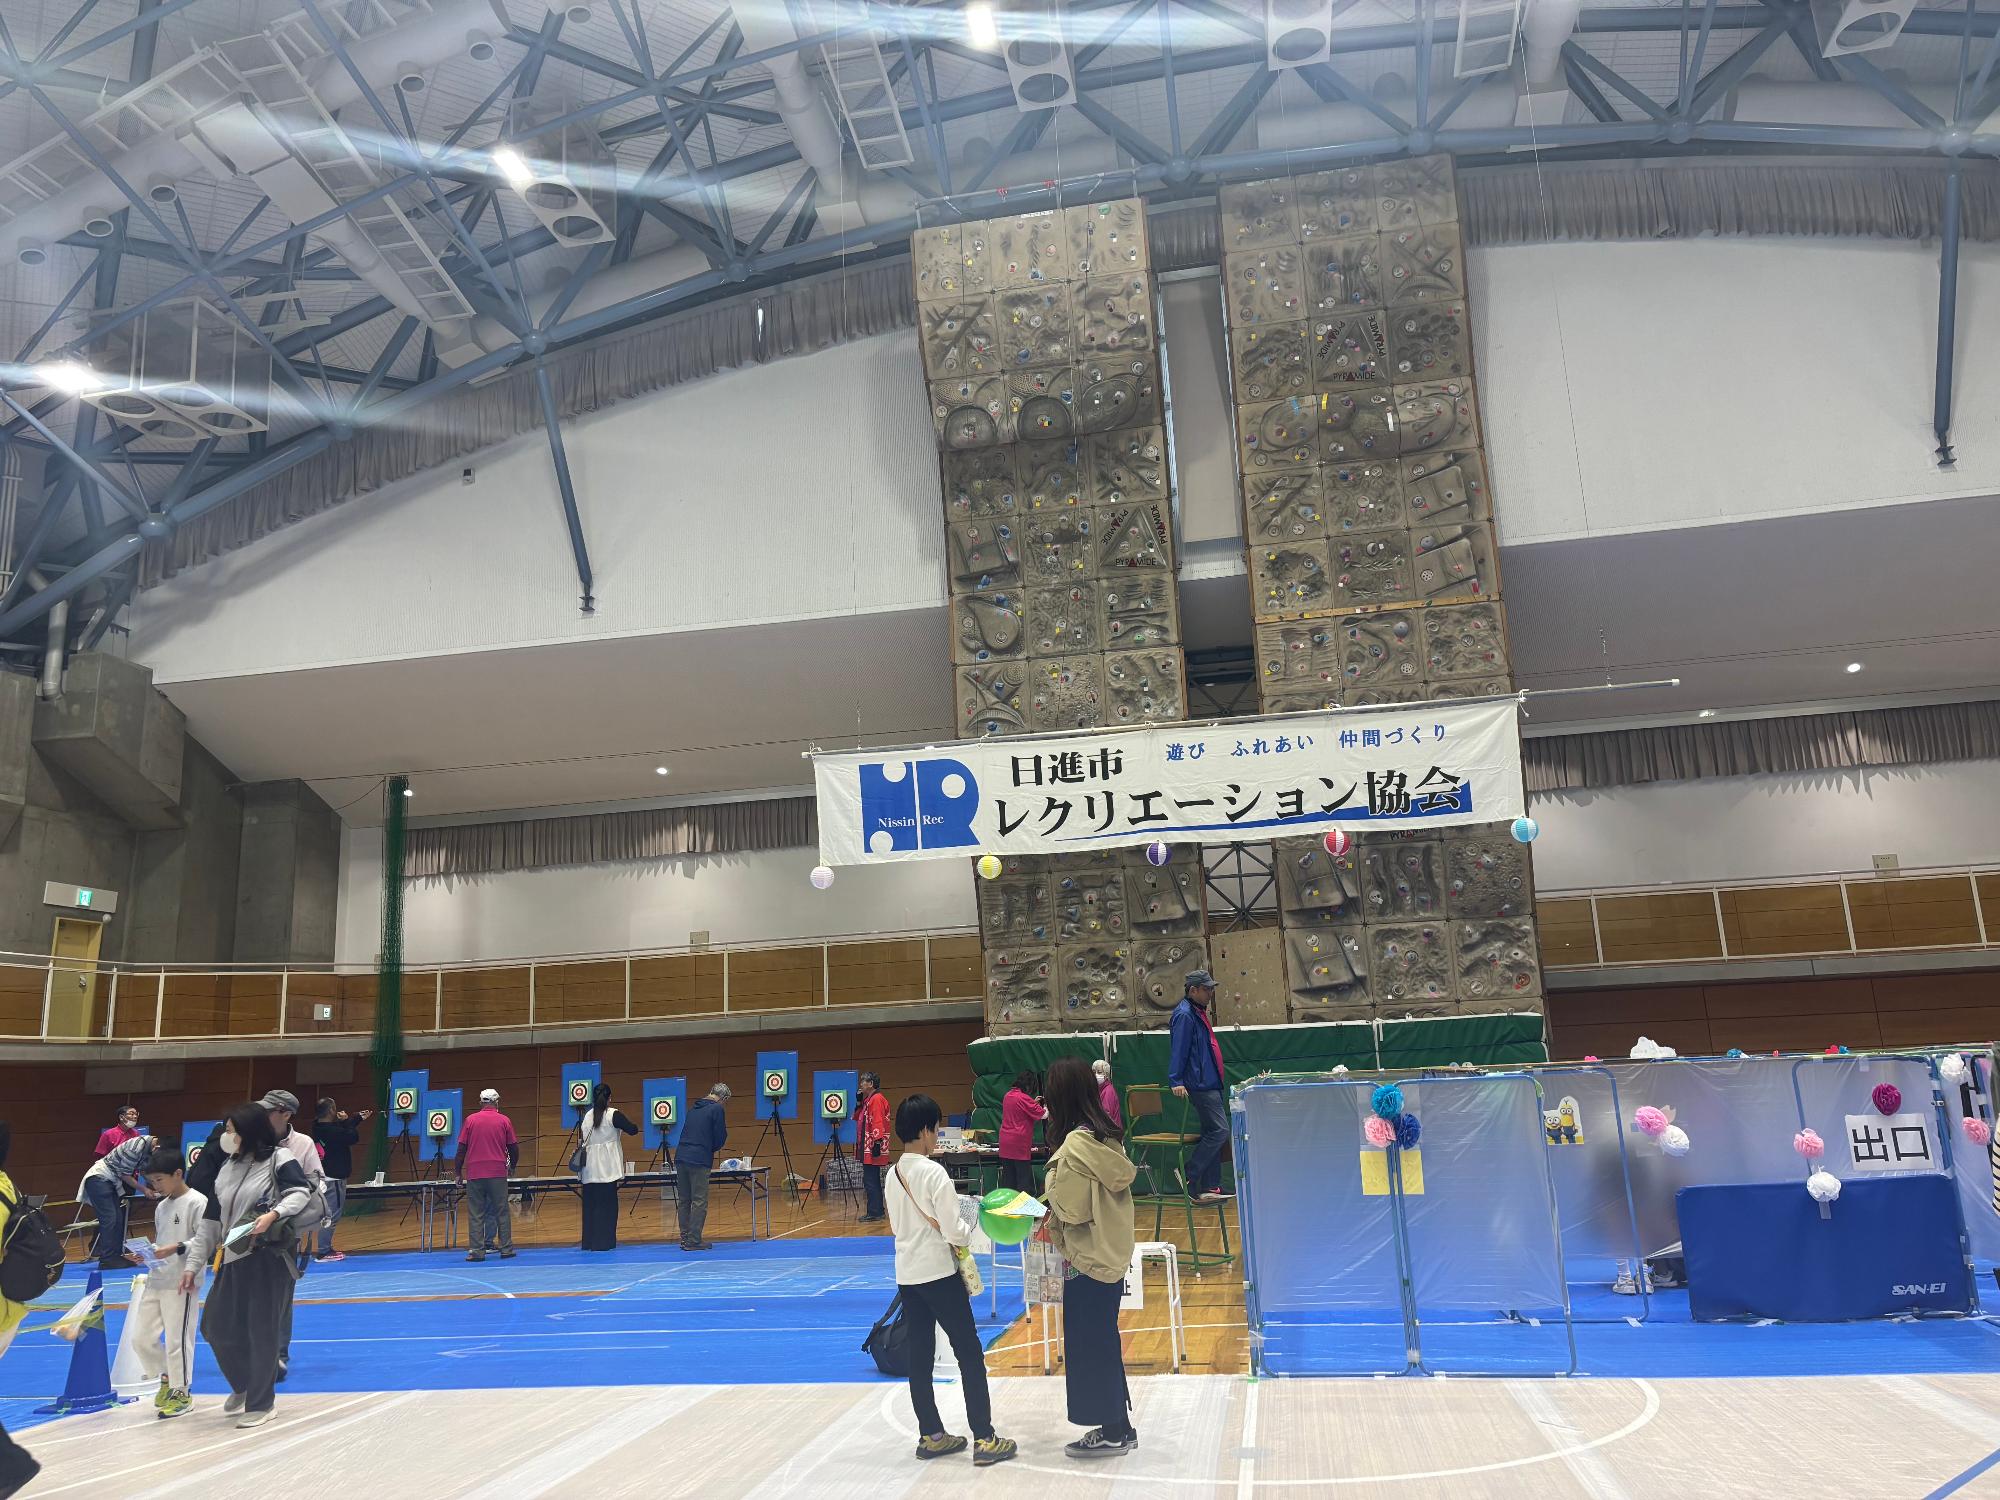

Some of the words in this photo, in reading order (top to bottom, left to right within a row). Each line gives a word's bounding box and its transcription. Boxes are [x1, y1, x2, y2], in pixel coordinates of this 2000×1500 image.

[1166, 742, 1205, 761] 遊び
[1231, 735, 1314, 757] ふれあい
[1339, 724, 1446, 749] 仲間づくり
[1010, 748, 1124, 787] 日進市
[995, 765, 1462, 837] レクリエーション協会
[878, 816, 915, 828] Nissin
[922, 814, 945, 825] Rec
[1852, 1125, 1929, 1162] 出口
